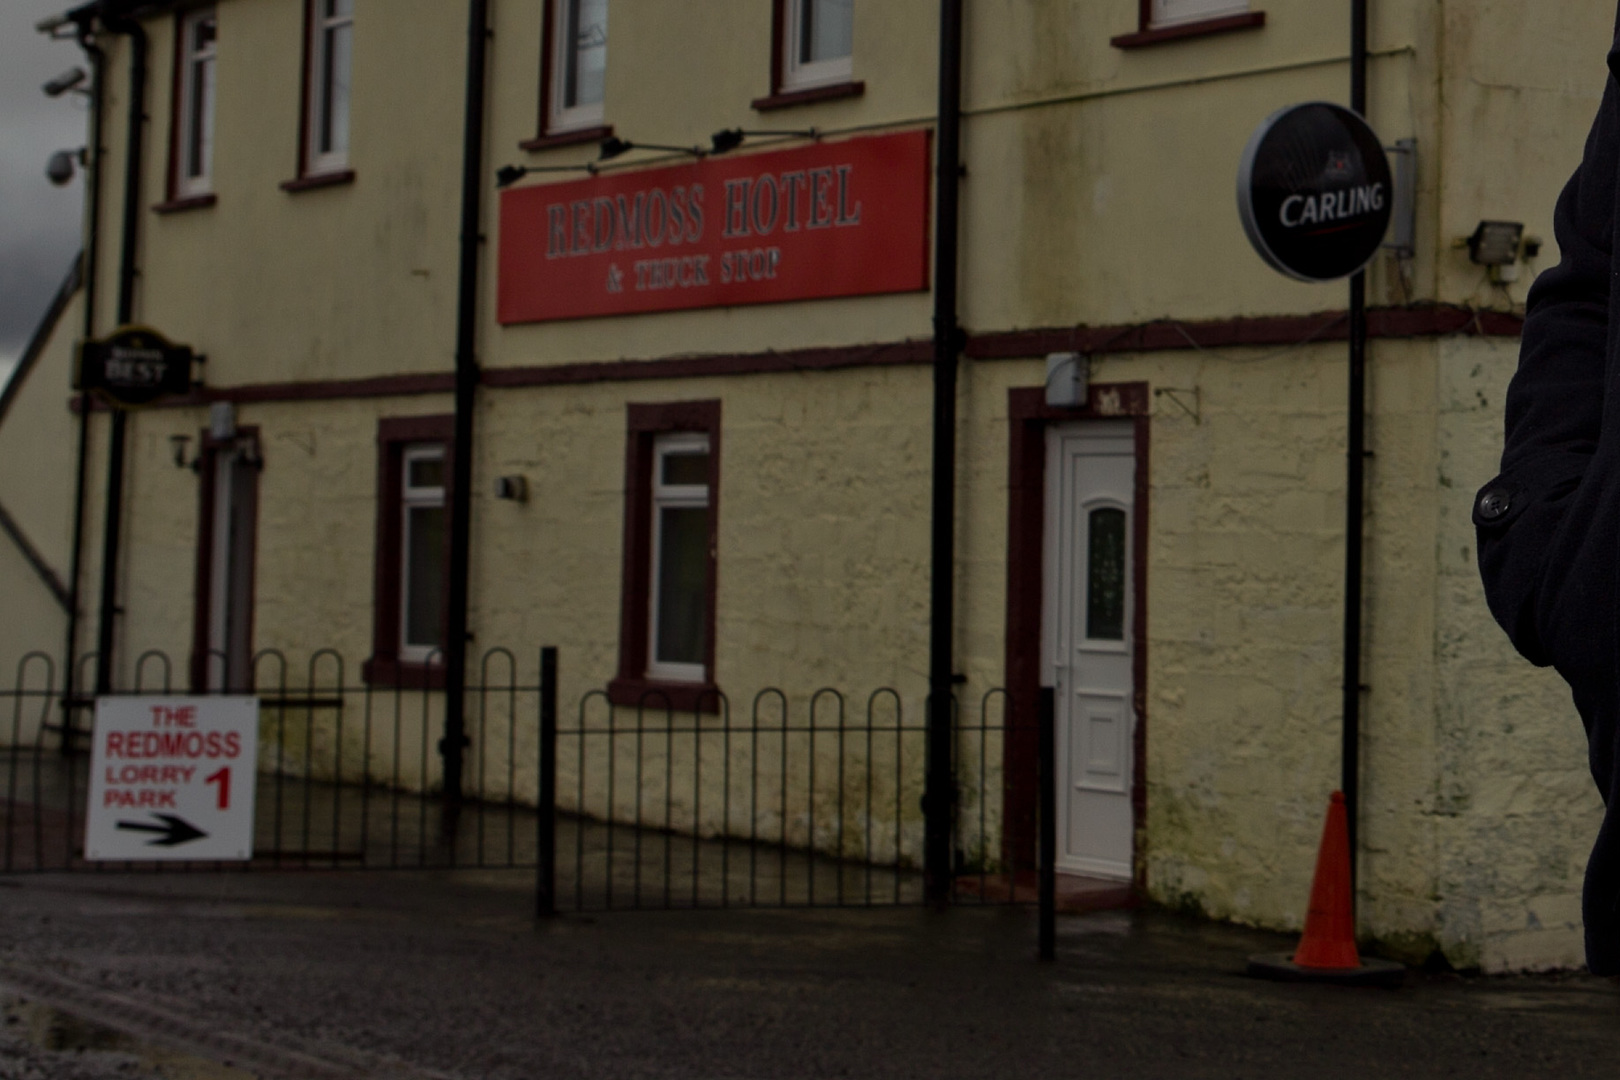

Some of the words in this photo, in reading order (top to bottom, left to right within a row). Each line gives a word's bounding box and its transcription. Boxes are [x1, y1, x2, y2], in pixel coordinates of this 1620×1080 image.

[280, 182, 384, 227] CARLING
[546, 184, 705, 259] REDMOSS
[723, 165, 861, 239] HOTEL
[606, 264, 624, 293] &
[635, 255, 709, 291] TRUCK
[721, 247, 781, 284] STOP
[104, 360, 168, 384] BEST
[151, 705, 197, 728] THE
[105, 731, 242, 759] REDMOSS
[105, 765, 197, 785] LORRY
[204, 766, 232, 810] 1
[103, 789, 177, 809] PARK
